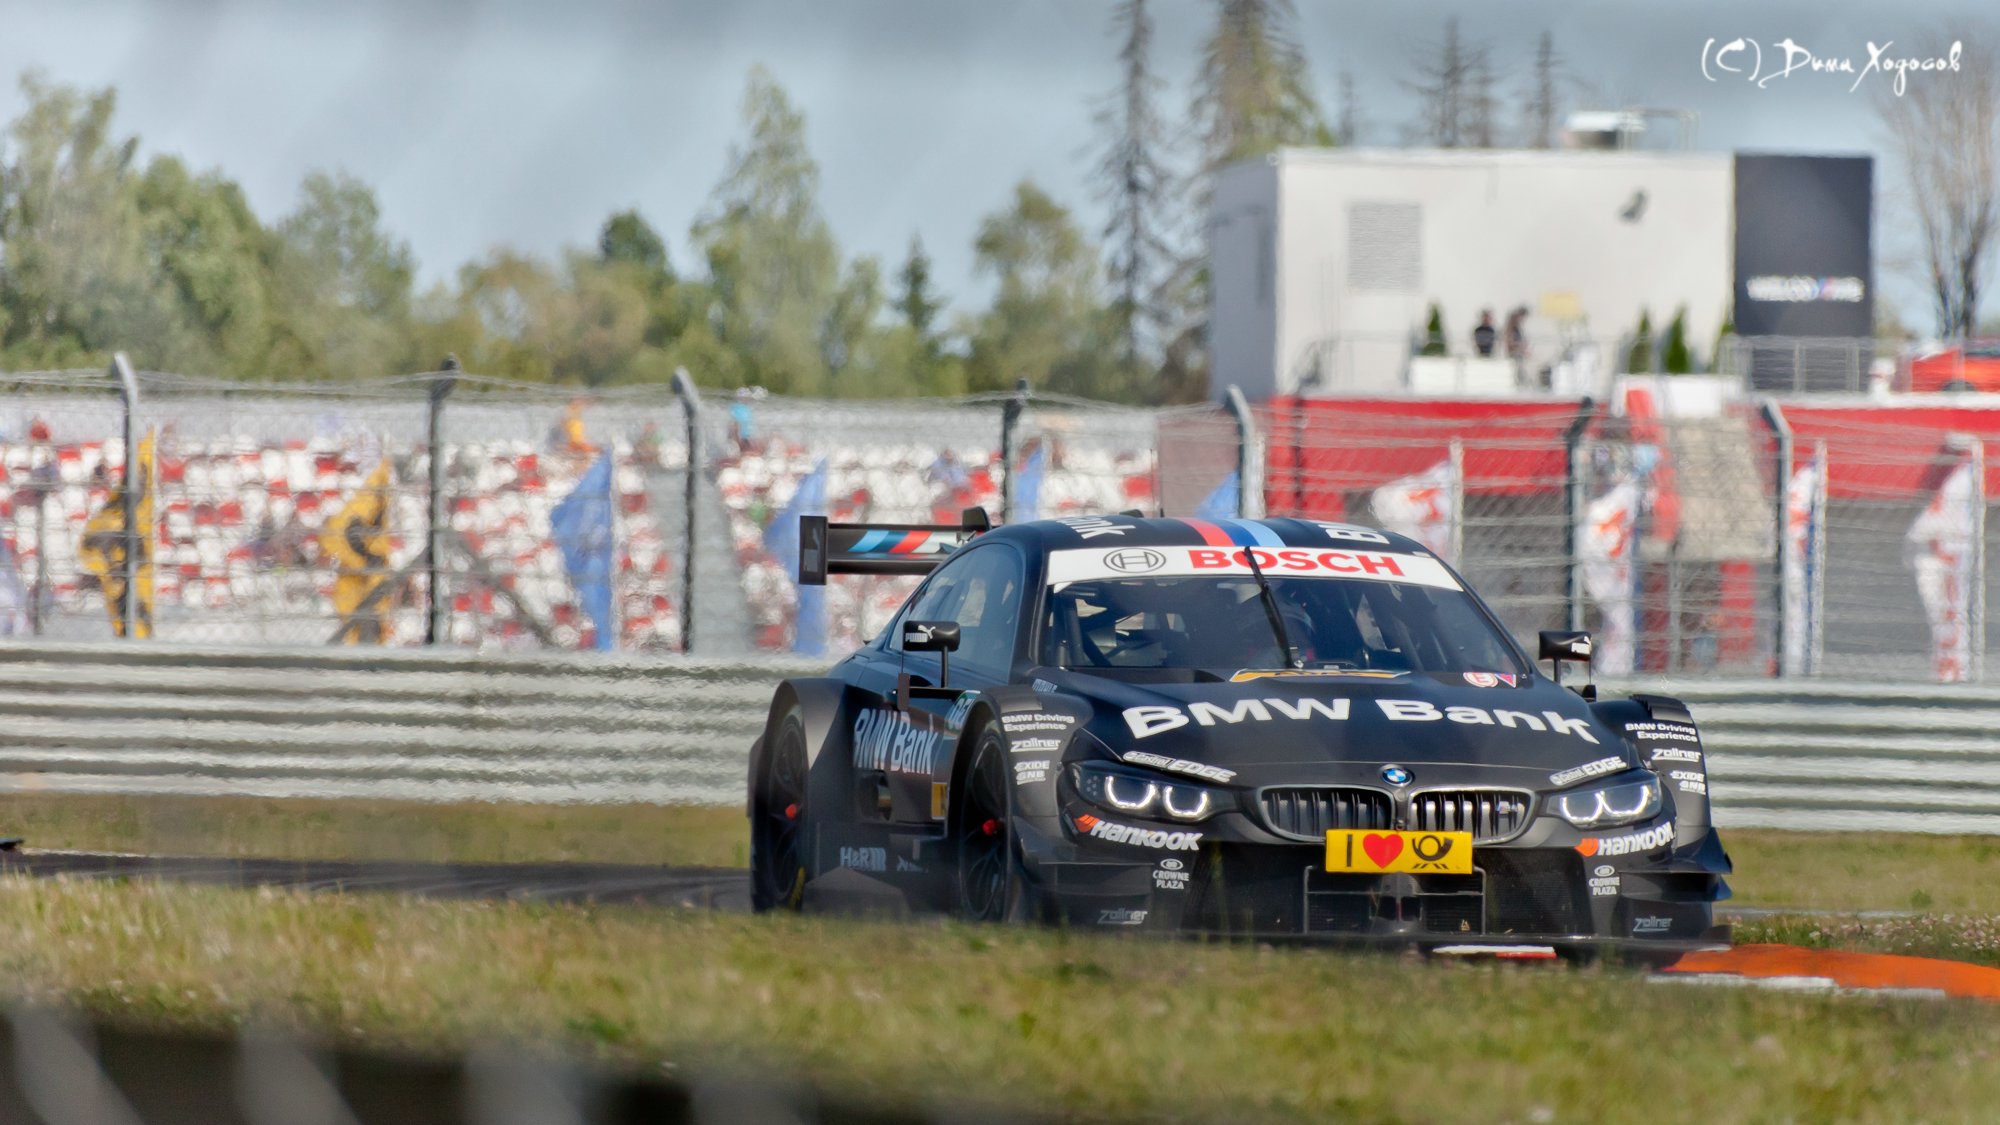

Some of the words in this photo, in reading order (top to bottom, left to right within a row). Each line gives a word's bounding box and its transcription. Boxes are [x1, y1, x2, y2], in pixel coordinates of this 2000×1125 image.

[1187, 549, 1405, 577] BOSCH
[1001, 714, 1033, 724] BMW
[1034, 713, 1075, 724] Driving
[1121, 698, 1350, 739] BMW
[1375, 698, 1600, 745] Bank
[1003, 722, 1068, 732] Experience
[1625, 722, 1657, 732] BMW
[1658, 722, 1697, 736] Driving
[853, 707, 897, 770] BMW
[890, 711, 939, 775] Bank
[1636, 731, 1699, 743] Experience
[1014, 760, 1051, 772] EXIDE
[1167, 759, 1237, 783] EDGE
[1580, 755, 1628, 776] EDGE
[1670, 770, 1706, 783] EXIDE
[1152, 869, 1190, 881] CROWNE
[1156, 880, 1185, 890] PLAZA
[1588, 876, 1620, 888] CROWNE
[1592, 886, 1618, 896] PLAZA
